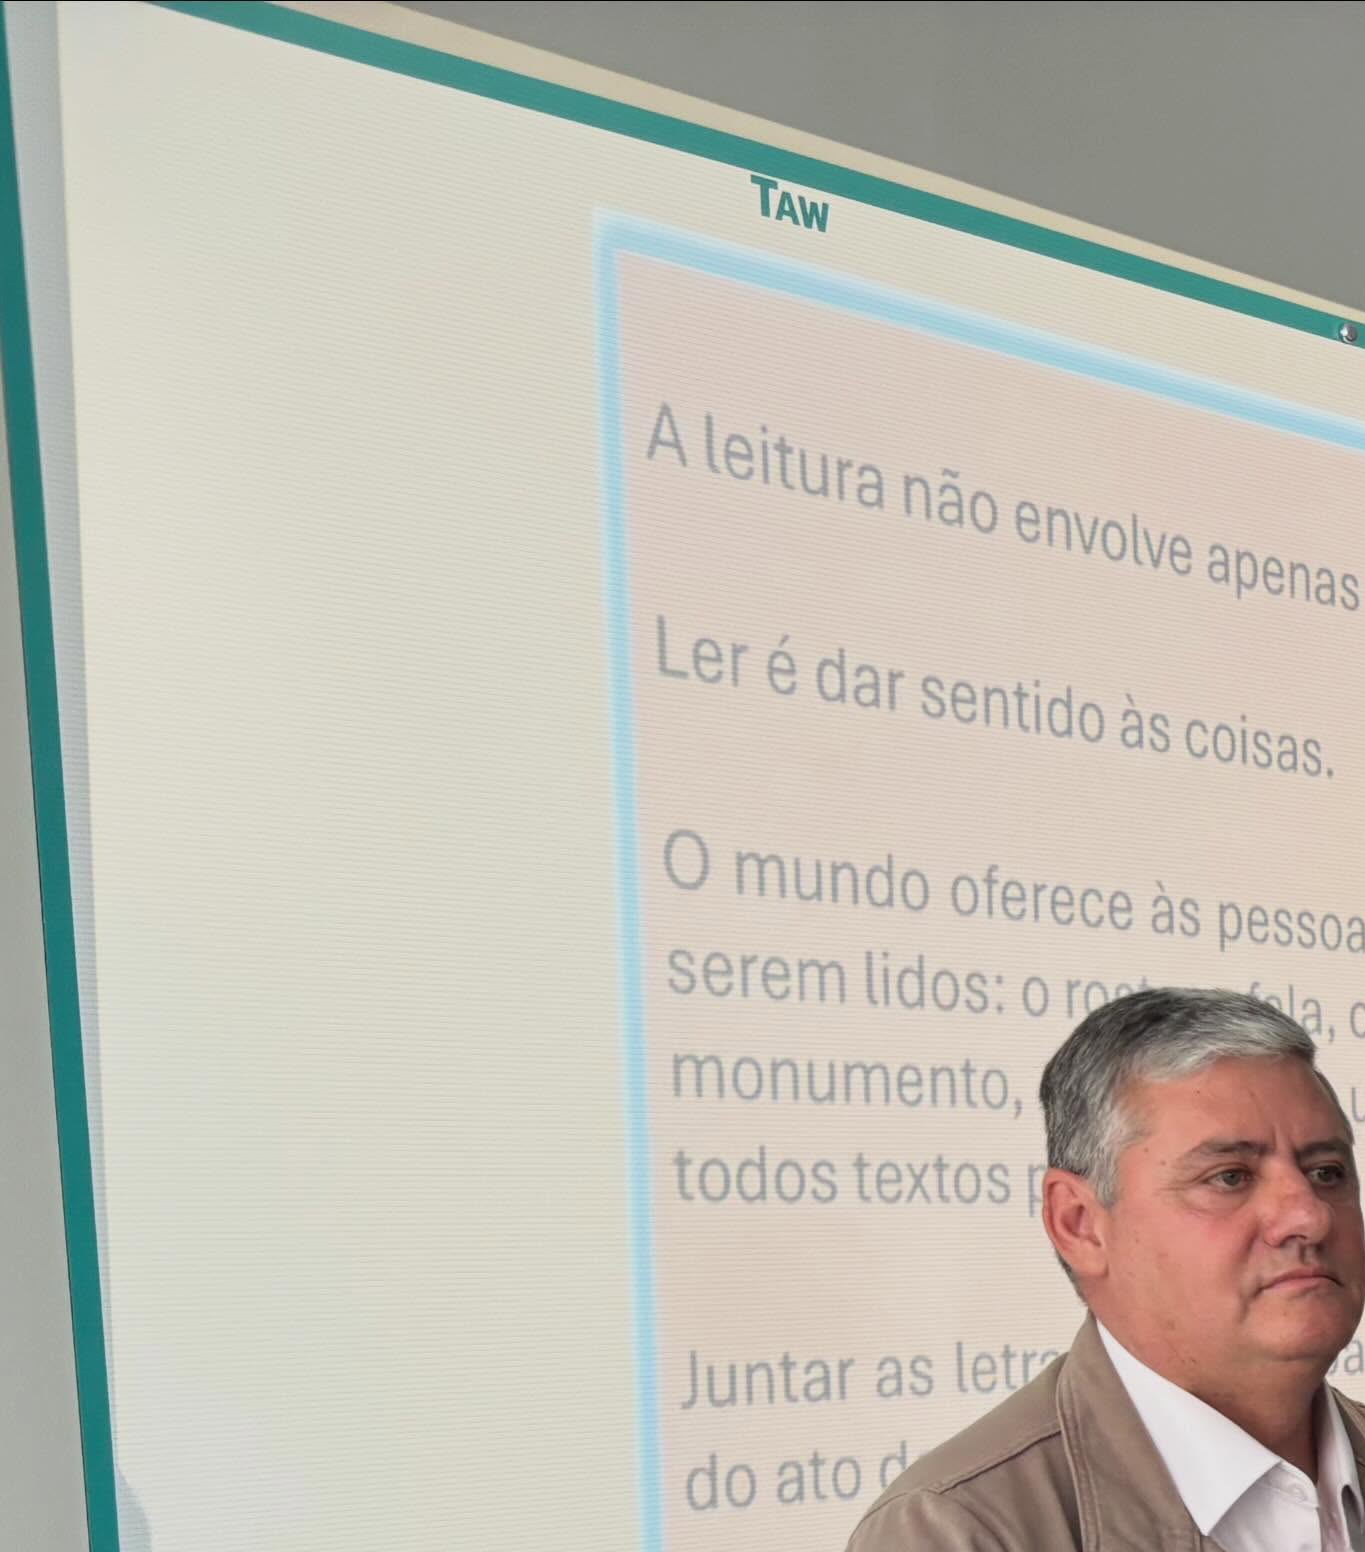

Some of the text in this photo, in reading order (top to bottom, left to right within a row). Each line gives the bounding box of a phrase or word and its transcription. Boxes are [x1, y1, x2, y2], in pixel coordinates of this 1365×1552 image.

[646, 401, 687, 468] A
[704, 412, 885, 508] leitura
[903, 467, 999, 534] não
[1015, 499, 1193, 576] envolve
[1207, 543, 1361, 611] apenas
[655, 613, 1335, 778] Ler é dar sentido às coisas.
[663, 829, 711, 891] O
[734, 848, 931, 912] mundo
[950, 865, 1134, 931] oferece
[1150, 880, 1201, 938] às
[667, 946, 846, 1004] serem
[864, 950, 1005, 1016] lidos:
[1022, 975, 1050, 1018] o
[672, 1049, 1024, 1120] monumento,
[672, 1146, 840, 1206] todos
[856, 1152, 1012, 1206] textos
[682, 1349, 855, 1410] Juntar
[876, 1354, 936, 1400] as
[685, 1453, 757, 1511] do
[776, 1451, 862, 1504] ato
